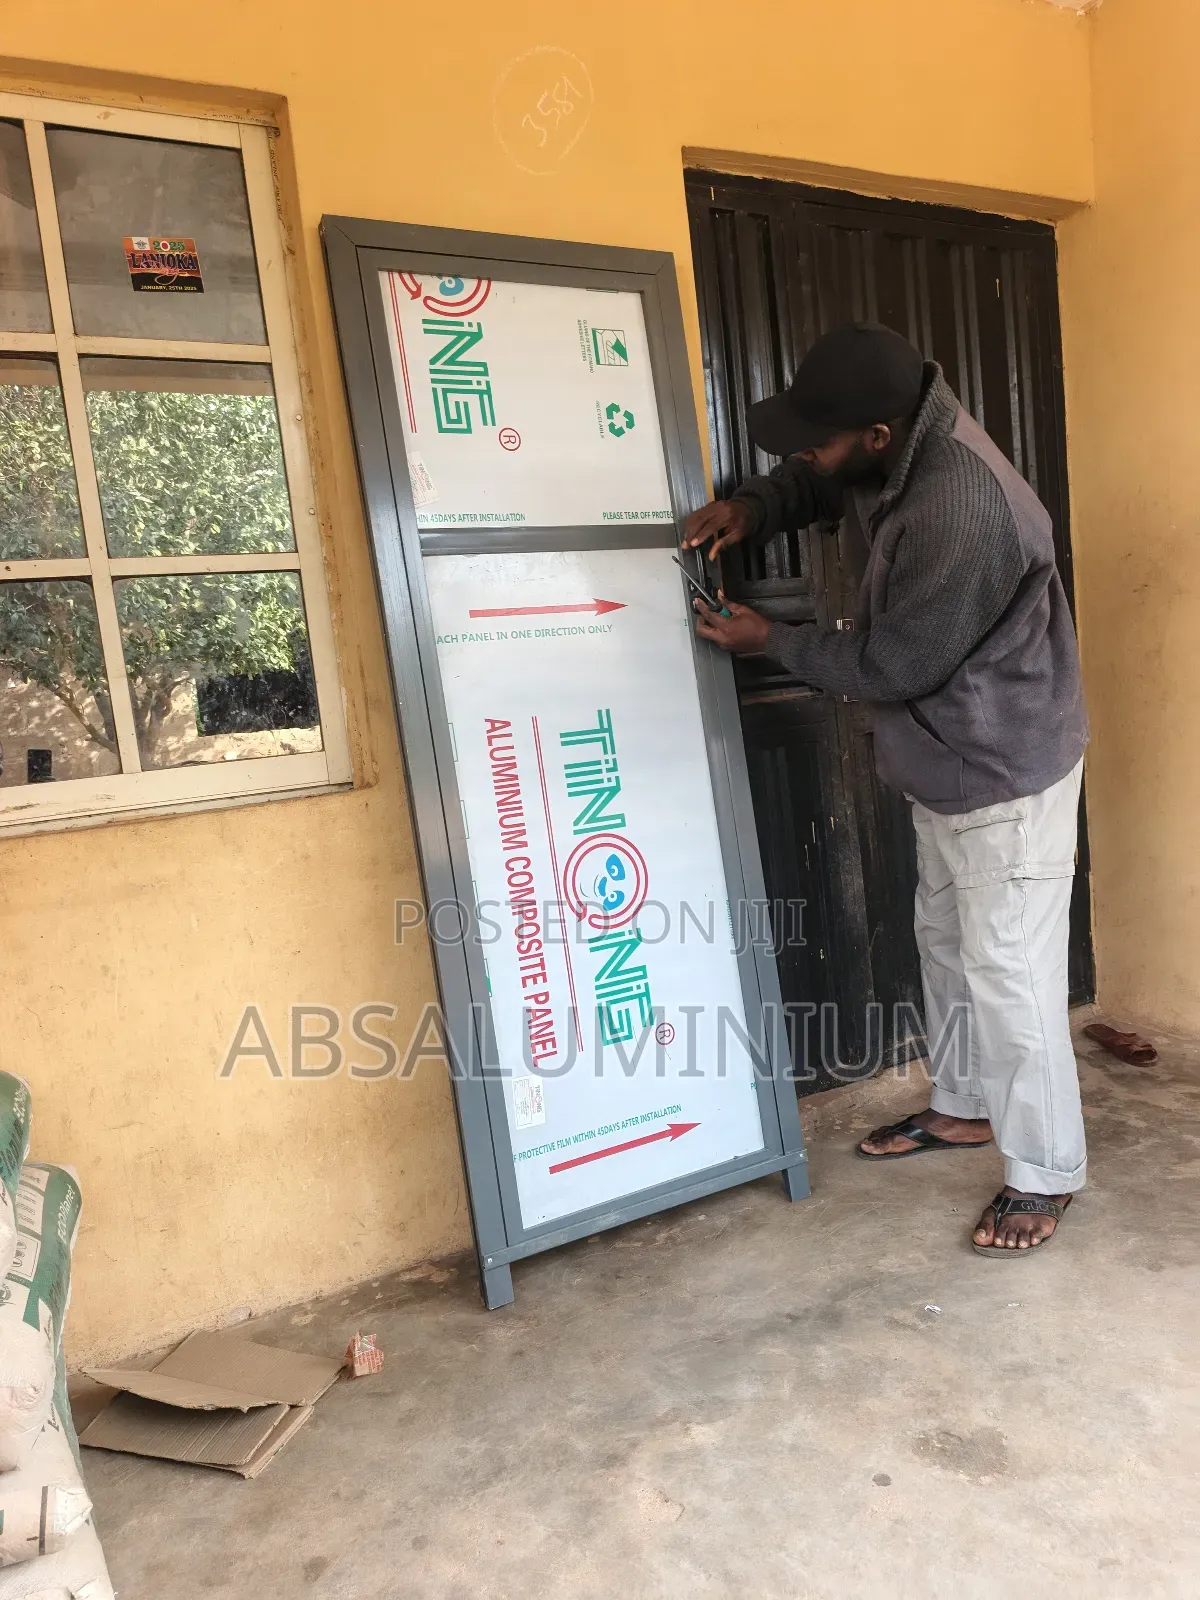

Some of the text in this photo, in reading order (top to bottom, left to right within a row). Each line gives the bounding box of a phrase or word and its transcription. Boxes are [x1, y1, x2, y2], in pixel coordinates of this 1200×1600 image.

[152, 240, 186, 252] 2025
[430, 513, 456, 523] 45DAYS
[458, 512, 478, 523] AFTER
[480, 511, 526, 522] INSTALLATION
[602, 511, 624, 520] PLEASE
[624, 511, 640, 520] TEAR
[640, 511, 651, 520] OFF
[461, 631, 495, 642] PANEL
[496, 631, 508, 641] IN
[511, 629, 533, 639] ONE
[534, 625, 586, 638] DIRECTION
[587, 624, 613, 634] ONLY
[484, 718, 529, 852] ALUMINIUM
[504, 856, 548, 989] COMPOSITE
[523, 990, 558, 1068] PANEL
[518, 1142, 556, 1161] PROTECTIVE
[557, 1136, 572, 1150] FILM
[572, 1129, 597, 1144] WITHIN
[597, 1122, 621, 1137] 45DAYS
[621, 1116, 640, 1130] AFTER
[640, 1103, 682, 1124] INSTALLATION
